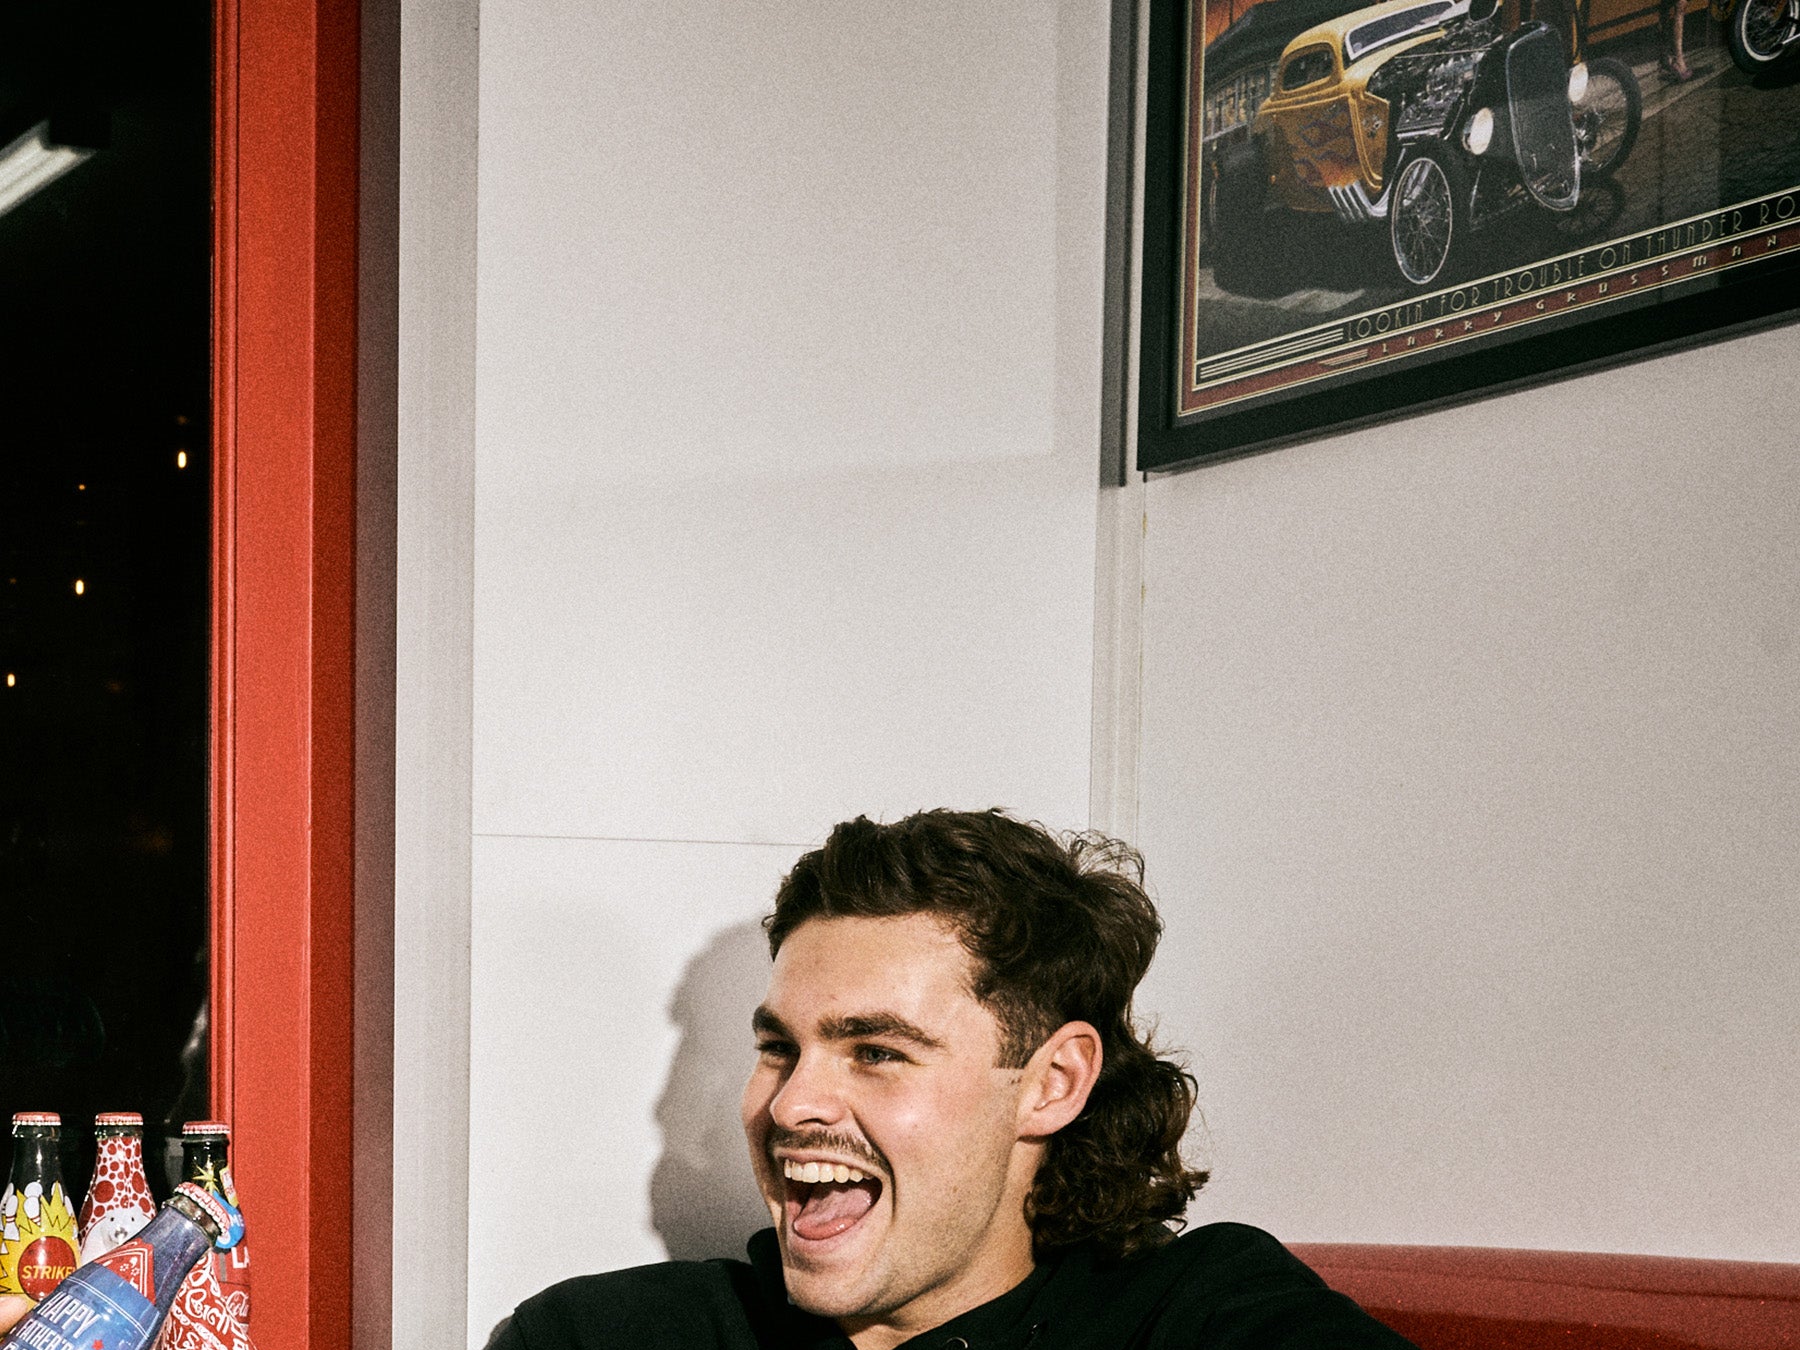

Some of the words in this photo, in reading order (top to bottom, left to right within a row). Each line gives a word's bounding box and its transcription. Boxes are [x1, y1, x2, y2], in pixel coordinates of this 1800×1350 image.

[1348, 300, 1430, 341] LOOKIN'
[1441, 287, 1481, 315] FOR
[1493, 254, 1586, 298] TROUBLE
[1600, 243, 1632, 269] ON
[1646, 210, 1744, 257] THUNDER
[1760, 195, 1796, 225] RO
[37, 1290, 102, 1340] HAPPY
